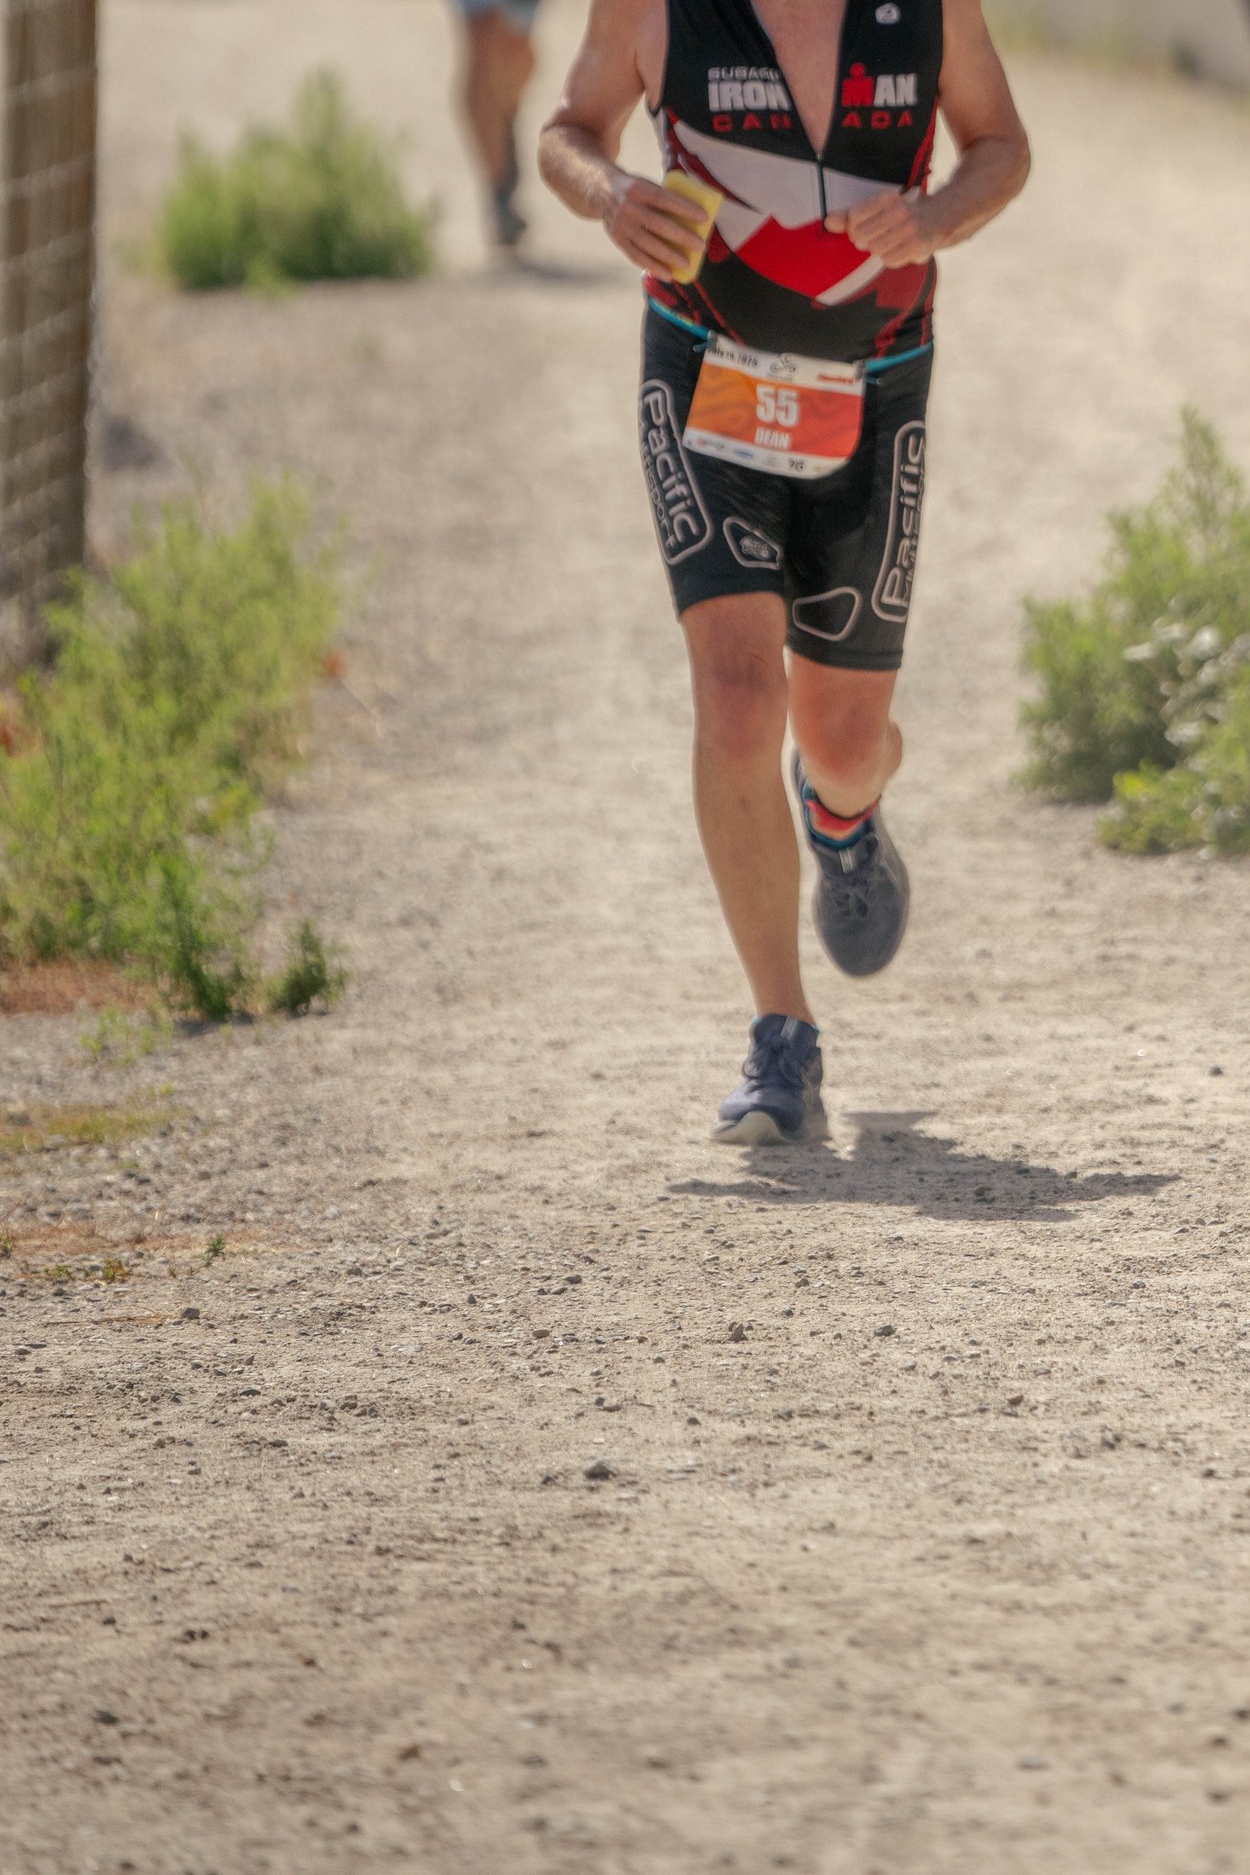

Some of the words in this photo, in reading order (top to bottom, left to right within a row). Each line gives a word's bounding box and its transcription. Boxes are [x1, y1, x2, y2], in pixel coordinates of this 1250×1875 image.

[708, 80, 792, 112] IRON
[756, 384, 799, 428] 55
[754, 427, 792, 451] DEAN
[643, 388, 700, 543] Pacific
